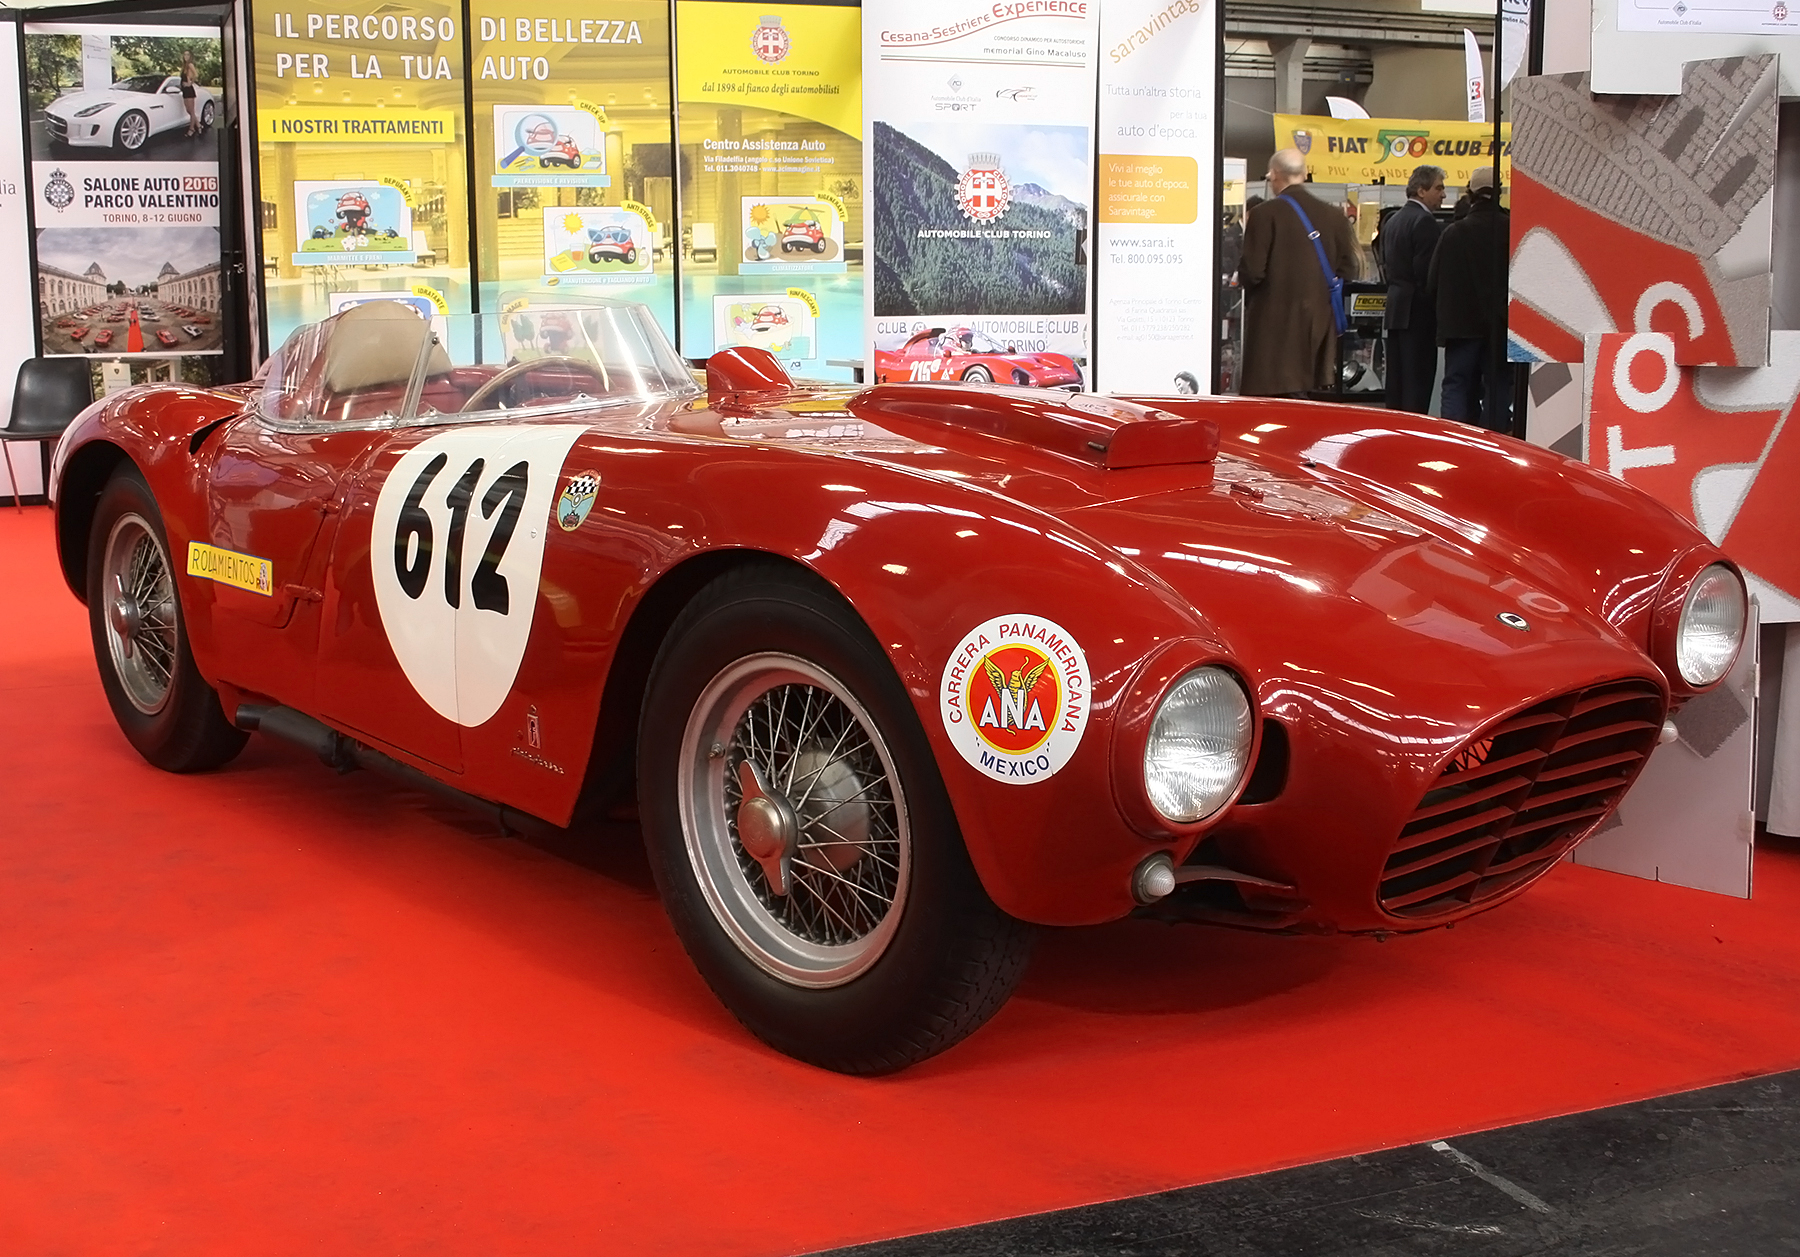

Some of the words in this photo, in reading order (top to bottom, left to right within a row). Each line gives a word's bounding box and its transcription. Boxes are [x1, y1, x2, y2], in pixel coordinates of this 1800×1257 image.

[880, 14, 990, 42] Cesana-Sestriere
[992, 1, 1087, 18] Experience
[274, 14, 300, 38] IL
[307, 14, 455, 42] PERCORSO
[480, 17, 506, 42] DI
[516, 18, 642, 44] BELLEZZA
[983, 47, 1023, 55] memorial
[1026, 48, 1045, 56] Gino
[1048, 49, 1086, 58] Macaluso
[276, 54, 330, 78] PER
[350, 54, 382, 79] LA
[400, 56, 452, 80] TUA
[480, 56, 550, 81] AUTO
[702, 82, 715, 92] dal
[717, 83, 736, 92] 1898
[738, 83, 745, 92] al
[745, 83, 770, 95] fianco
[771, 84, 789, 96] degli
[790, 85, 840, 95] automobilisti
[1106, 84, 1130, 96] Tutta
[1133, 86, 1167, 97] un'altra
[1170, 86, 1201, 98] storia
[580, 102, 606, 124] CHECK-UP
[935, 103, 977, 111] SPORT
[272, 120, 276, 134] I
[282, 120, 338, 134] NOSTRI
[342, 120, 444, 134] TRATTAMENTI
[1118, 125, 1144, 137] auto
[1148, 124, 1197, 140] d'epoca.
[703, 138, 740, 150] Centro
[742, 139, 799, 150] Assistenza
[800, 139, 826, 150] Auto
[1327, 136, 1368, 154] FIAT
[1374, 130, 1430, 164] 500
[1433, 140, 1481, 156] CLUB
[1108, 163, 1124, 173] Vivi
[1126, 164, 1133, 173] al
[1135, 164, 1163, 176] meglio
[1361, 167, 1409, 178] GRANDE
[83, 177, 140, 192] SALONE
[144, 177, 180, 191] AUTO
[184, 177, 217, 192] 2016
[1108, 178, 1116, 187] le
[1118, 179, 1133, 187] tue
[1134, 180, 1154, 188] auto
[1155, 180, 1189, 190] d'epoca,
[84, 194, 134, 208] PARCO
[139, 195, 219, 208] VALENTINO
[1108, 192, 1148, 202] assicurale
[1150, 194, 1165, 202] con
[103, 214, 141, 224] TORINO,
[168, 214, 202, 223] GIUGNO
[1108, 206, 1157, 218] Saravintage.
[917, 230, 982, 238] AUTOMOBILE
[984, 230, 1010, 238] CLUB
[1012, 230, 1051, 238] TORINO
[1110, 238, 1174, 248] www.sara.it
[1110, 254, 1125, 264] Tel.
[1128, 254, 1183, 264] 800.095.095
[417, 288, 444, 310] IDRATANTE
[877, 322, 907, 334] CLUB
[971, 321, 1044, 334] AUTOMOBILE
[1048, 321, 1079, 333] CLUB
[1002, 339, 1046, 352] TORINO
[394, 452, 529, 616] 612
[948, 634, 991, 724] CARRERA
[998, 622, 1083, 733] PANAMERICANA
[979, 688, 1046, 731] ANA
[980, 750, 1049, 776] MEXICO
